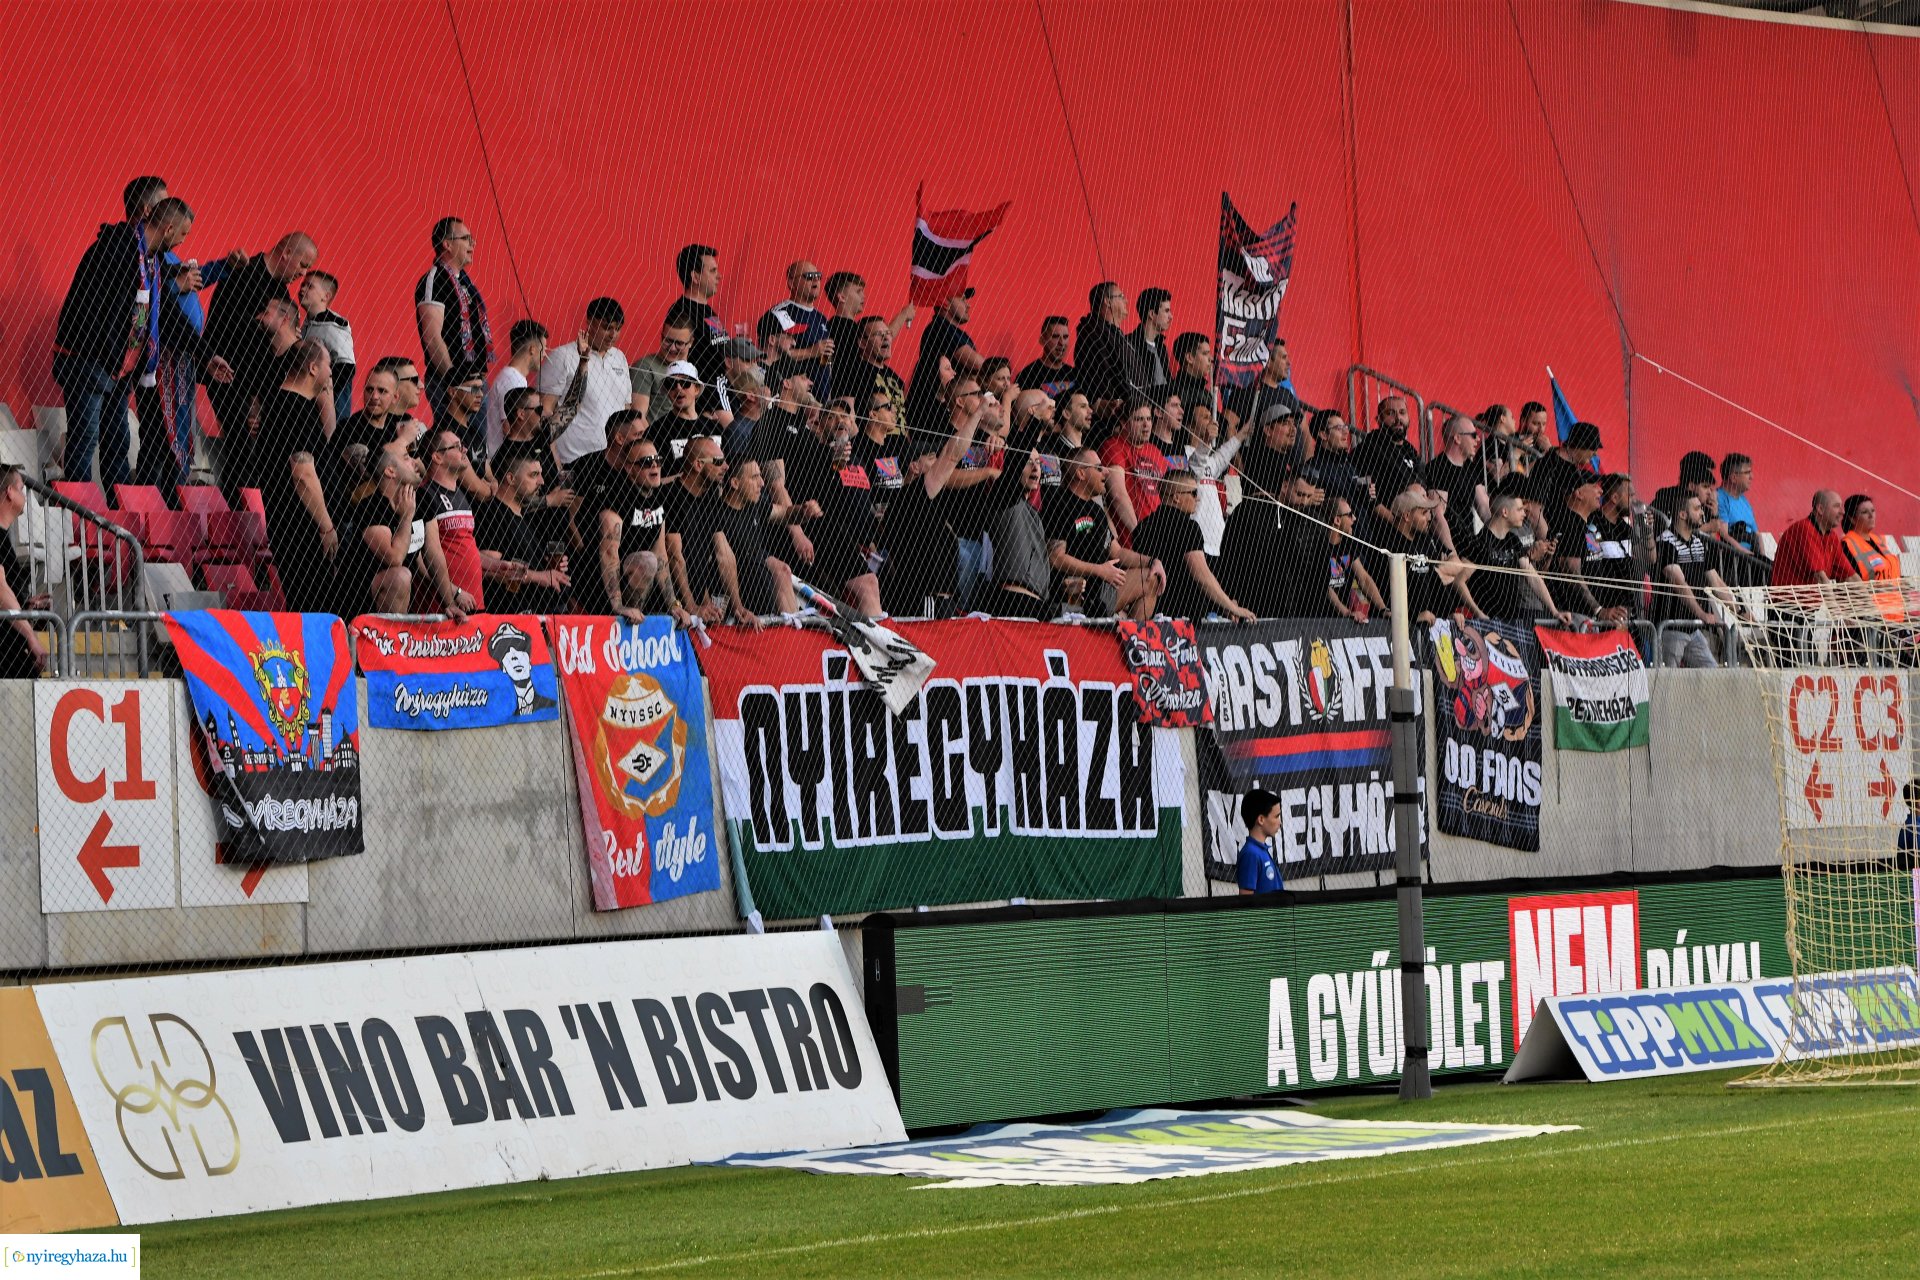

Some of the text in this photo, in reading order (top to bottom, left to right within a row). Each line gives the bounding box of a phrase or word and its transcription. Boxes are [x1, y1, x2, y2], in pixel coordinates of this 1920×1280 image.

[558, 621, 682, 675] Old School
[50, 688, 157, 804] C1
[610, 701, 663, 724] NYVSSC
[738, 648, 1159, 852] NYÍREGYHÁZA
[1788, 674, 1843, 755] C2
[1853, 674, 1905, 753] C3
[1482, 749, 1542, 807] FANS
[655, 815, 706, 883] Style
[1267, 977, 1299, 1087] A
[1514, 903, 1637, 1051] NEM
[232, 982, 863, 1144] VINO BAR 'N BISTRO
